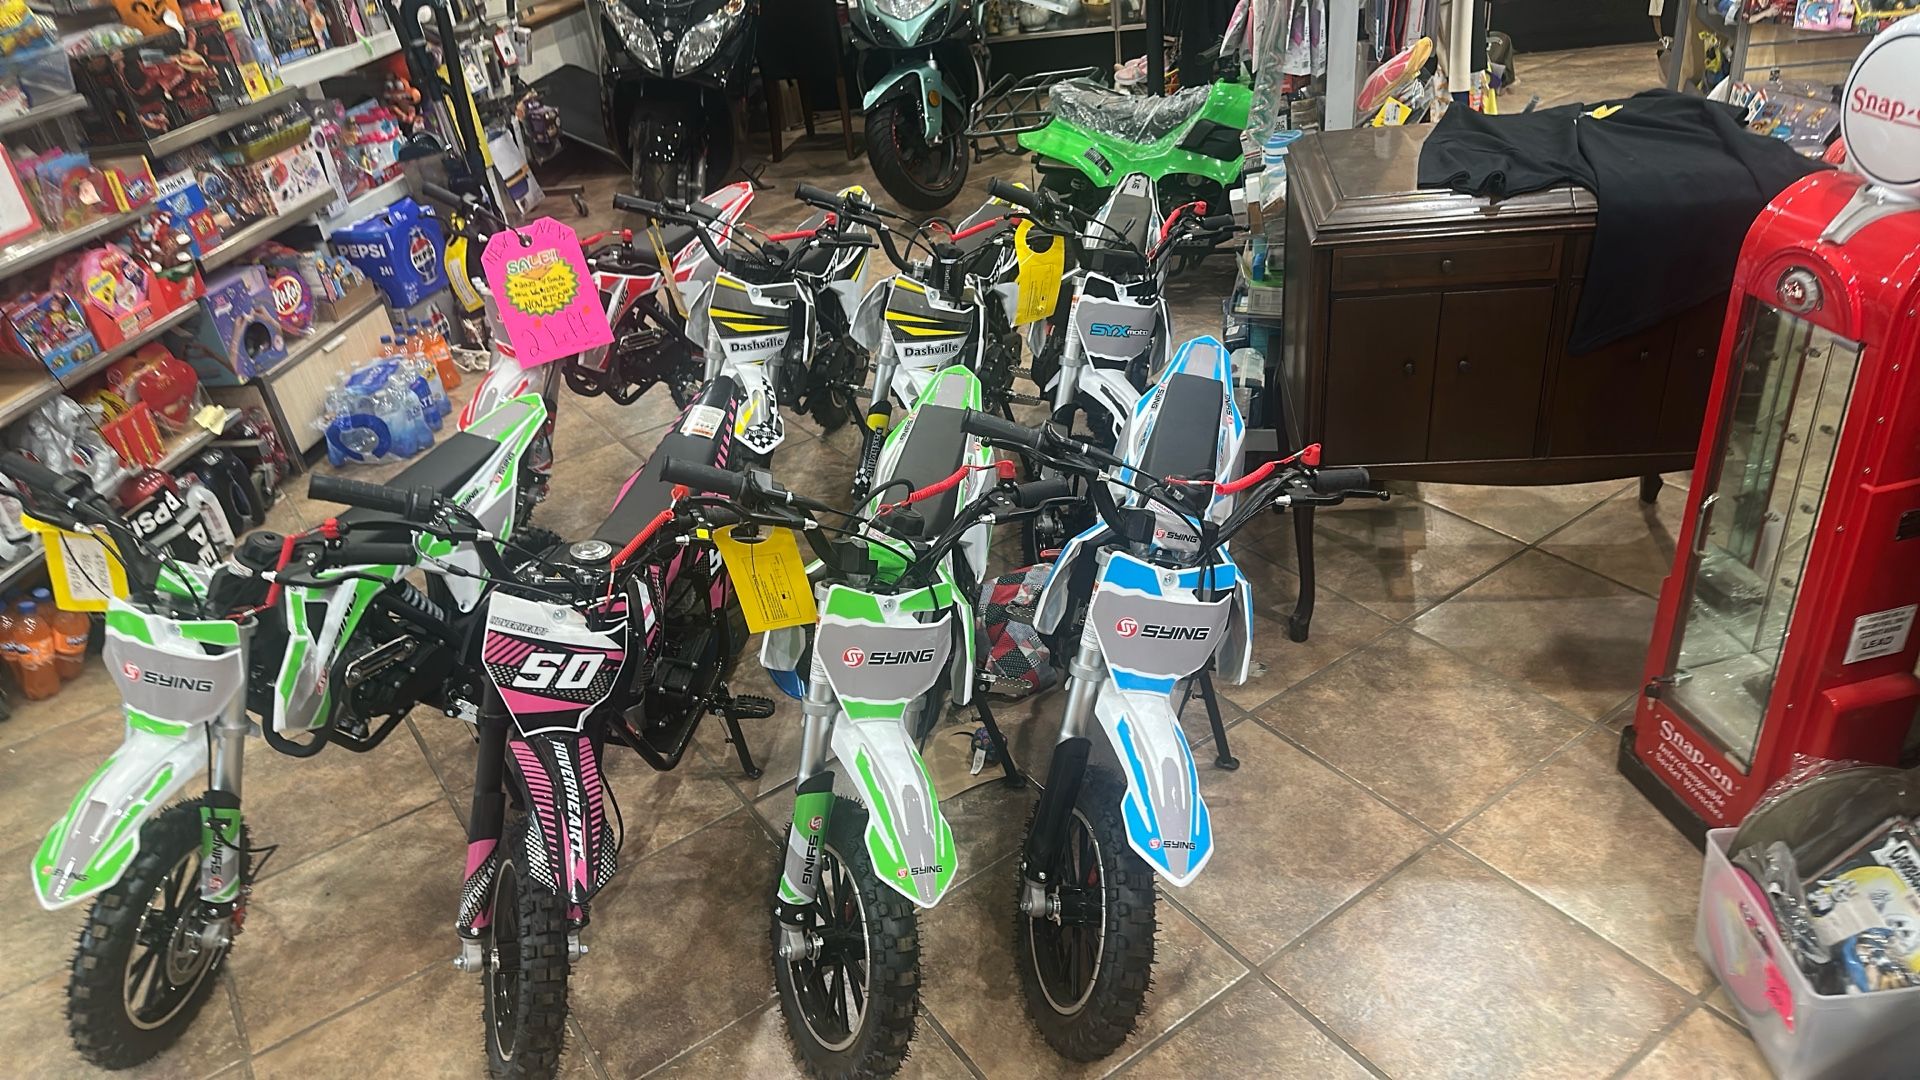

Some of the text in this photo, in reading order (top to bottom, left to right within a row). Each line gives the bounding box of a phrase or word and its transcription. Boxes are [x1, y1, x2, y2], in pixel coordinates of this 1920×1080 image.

[337, 243, 387, 259] PEPSI
[411, 244, 435, 265] PEPSI
[730, 336, 785, 352] Dashville
[904, 342, 959, 357] Dashville
[864, 427, 883, 479] Dashville
[1166, 531, 1199, 543] SYING
[489, 616, 550, 636] HOVERHEART
[1141, 624, 1211, 641] SYING
[868, 647, 935, 666] SYING
[511, 652, 607, 689] 50
[143, 670, 214, 693] SYING
[1660, 720, 1734, 794] Snap-on
[552, 741, 585, 860] HOVERHEART
[1163, 840, 1196, 850] SYING
[802, 834, 819, 885] SYING
[911, 865, 943, 876] SYING
